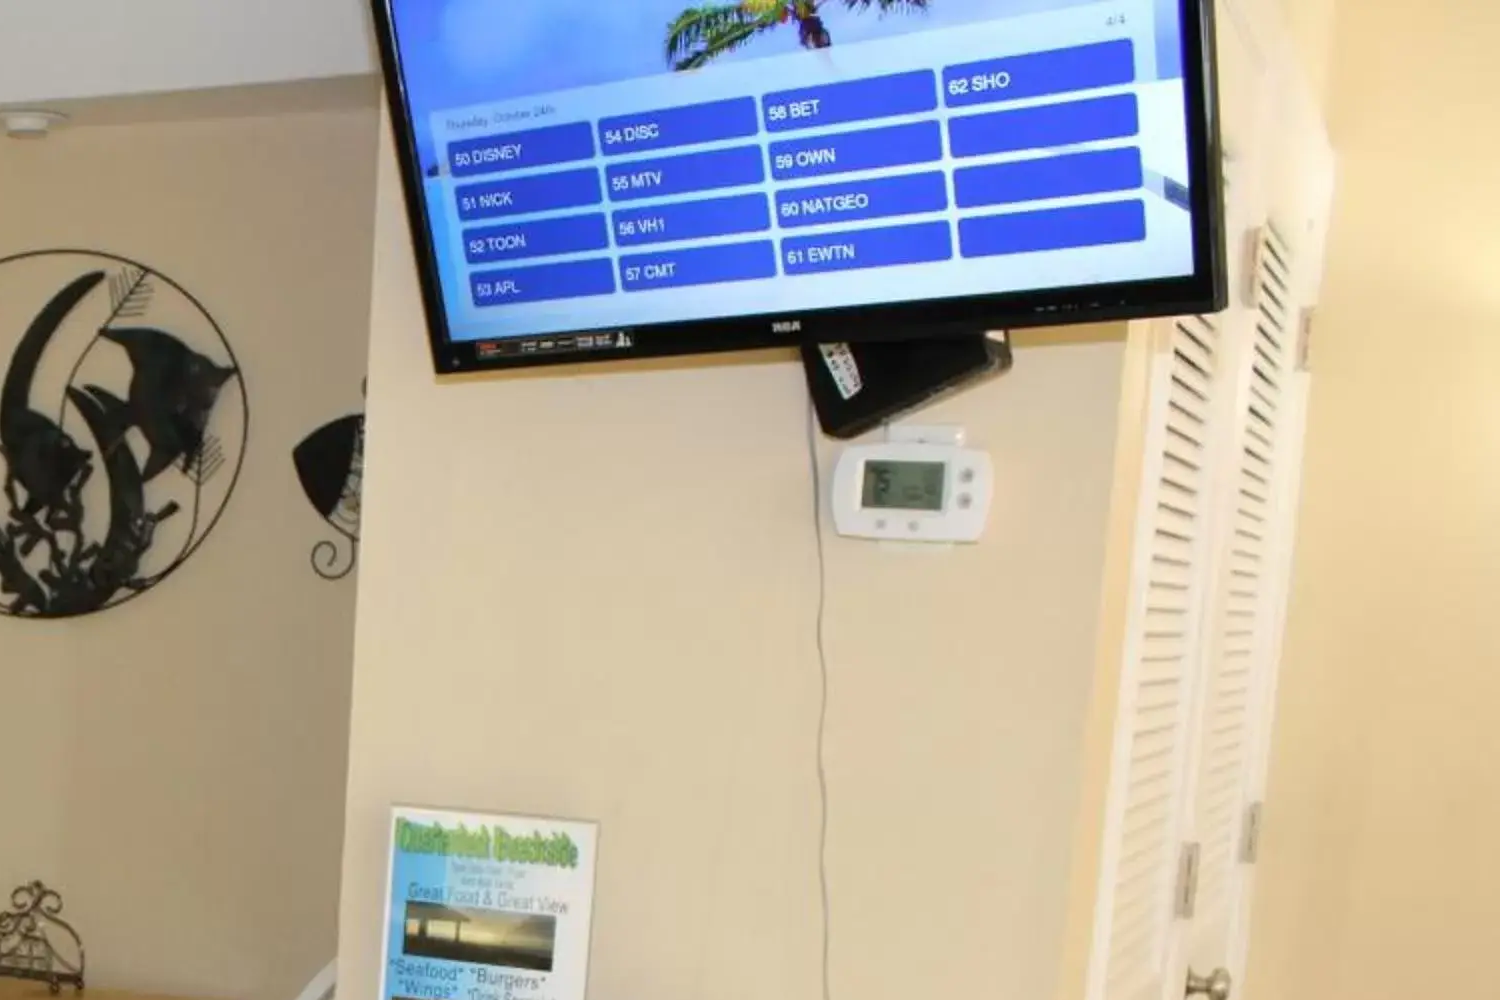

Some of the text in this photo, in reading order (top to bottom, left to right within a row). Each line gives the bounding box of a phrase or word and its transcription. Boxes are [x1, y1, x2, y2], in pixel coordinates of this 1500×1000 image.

[948, 71, 1011, 95] 62 SHO
[768, 99, 820, 121] 58 BET
[605, 123, 660, 145] 54 DISC
[455, 143, 522, 167] 50 DISNEY
[775, 147, 836, 169] 59 OWN
[611, 171, 662, 191] 55 MTV
[461, 191, 513, 211] 51 NICK
[780, 193, 869, 217] 60 NATGEO
[619, 217, 665, 236] 56 VH1
[469, 233, 527, 254] 52 TOON
[786, 243, 855, 265] 61 EWTN
[625, 262, 676, 281] 57 CMT
[476, 283, 493, 297] 53
[408, 881, 444, 900] Great
[499, 891, 534, 911] Great
